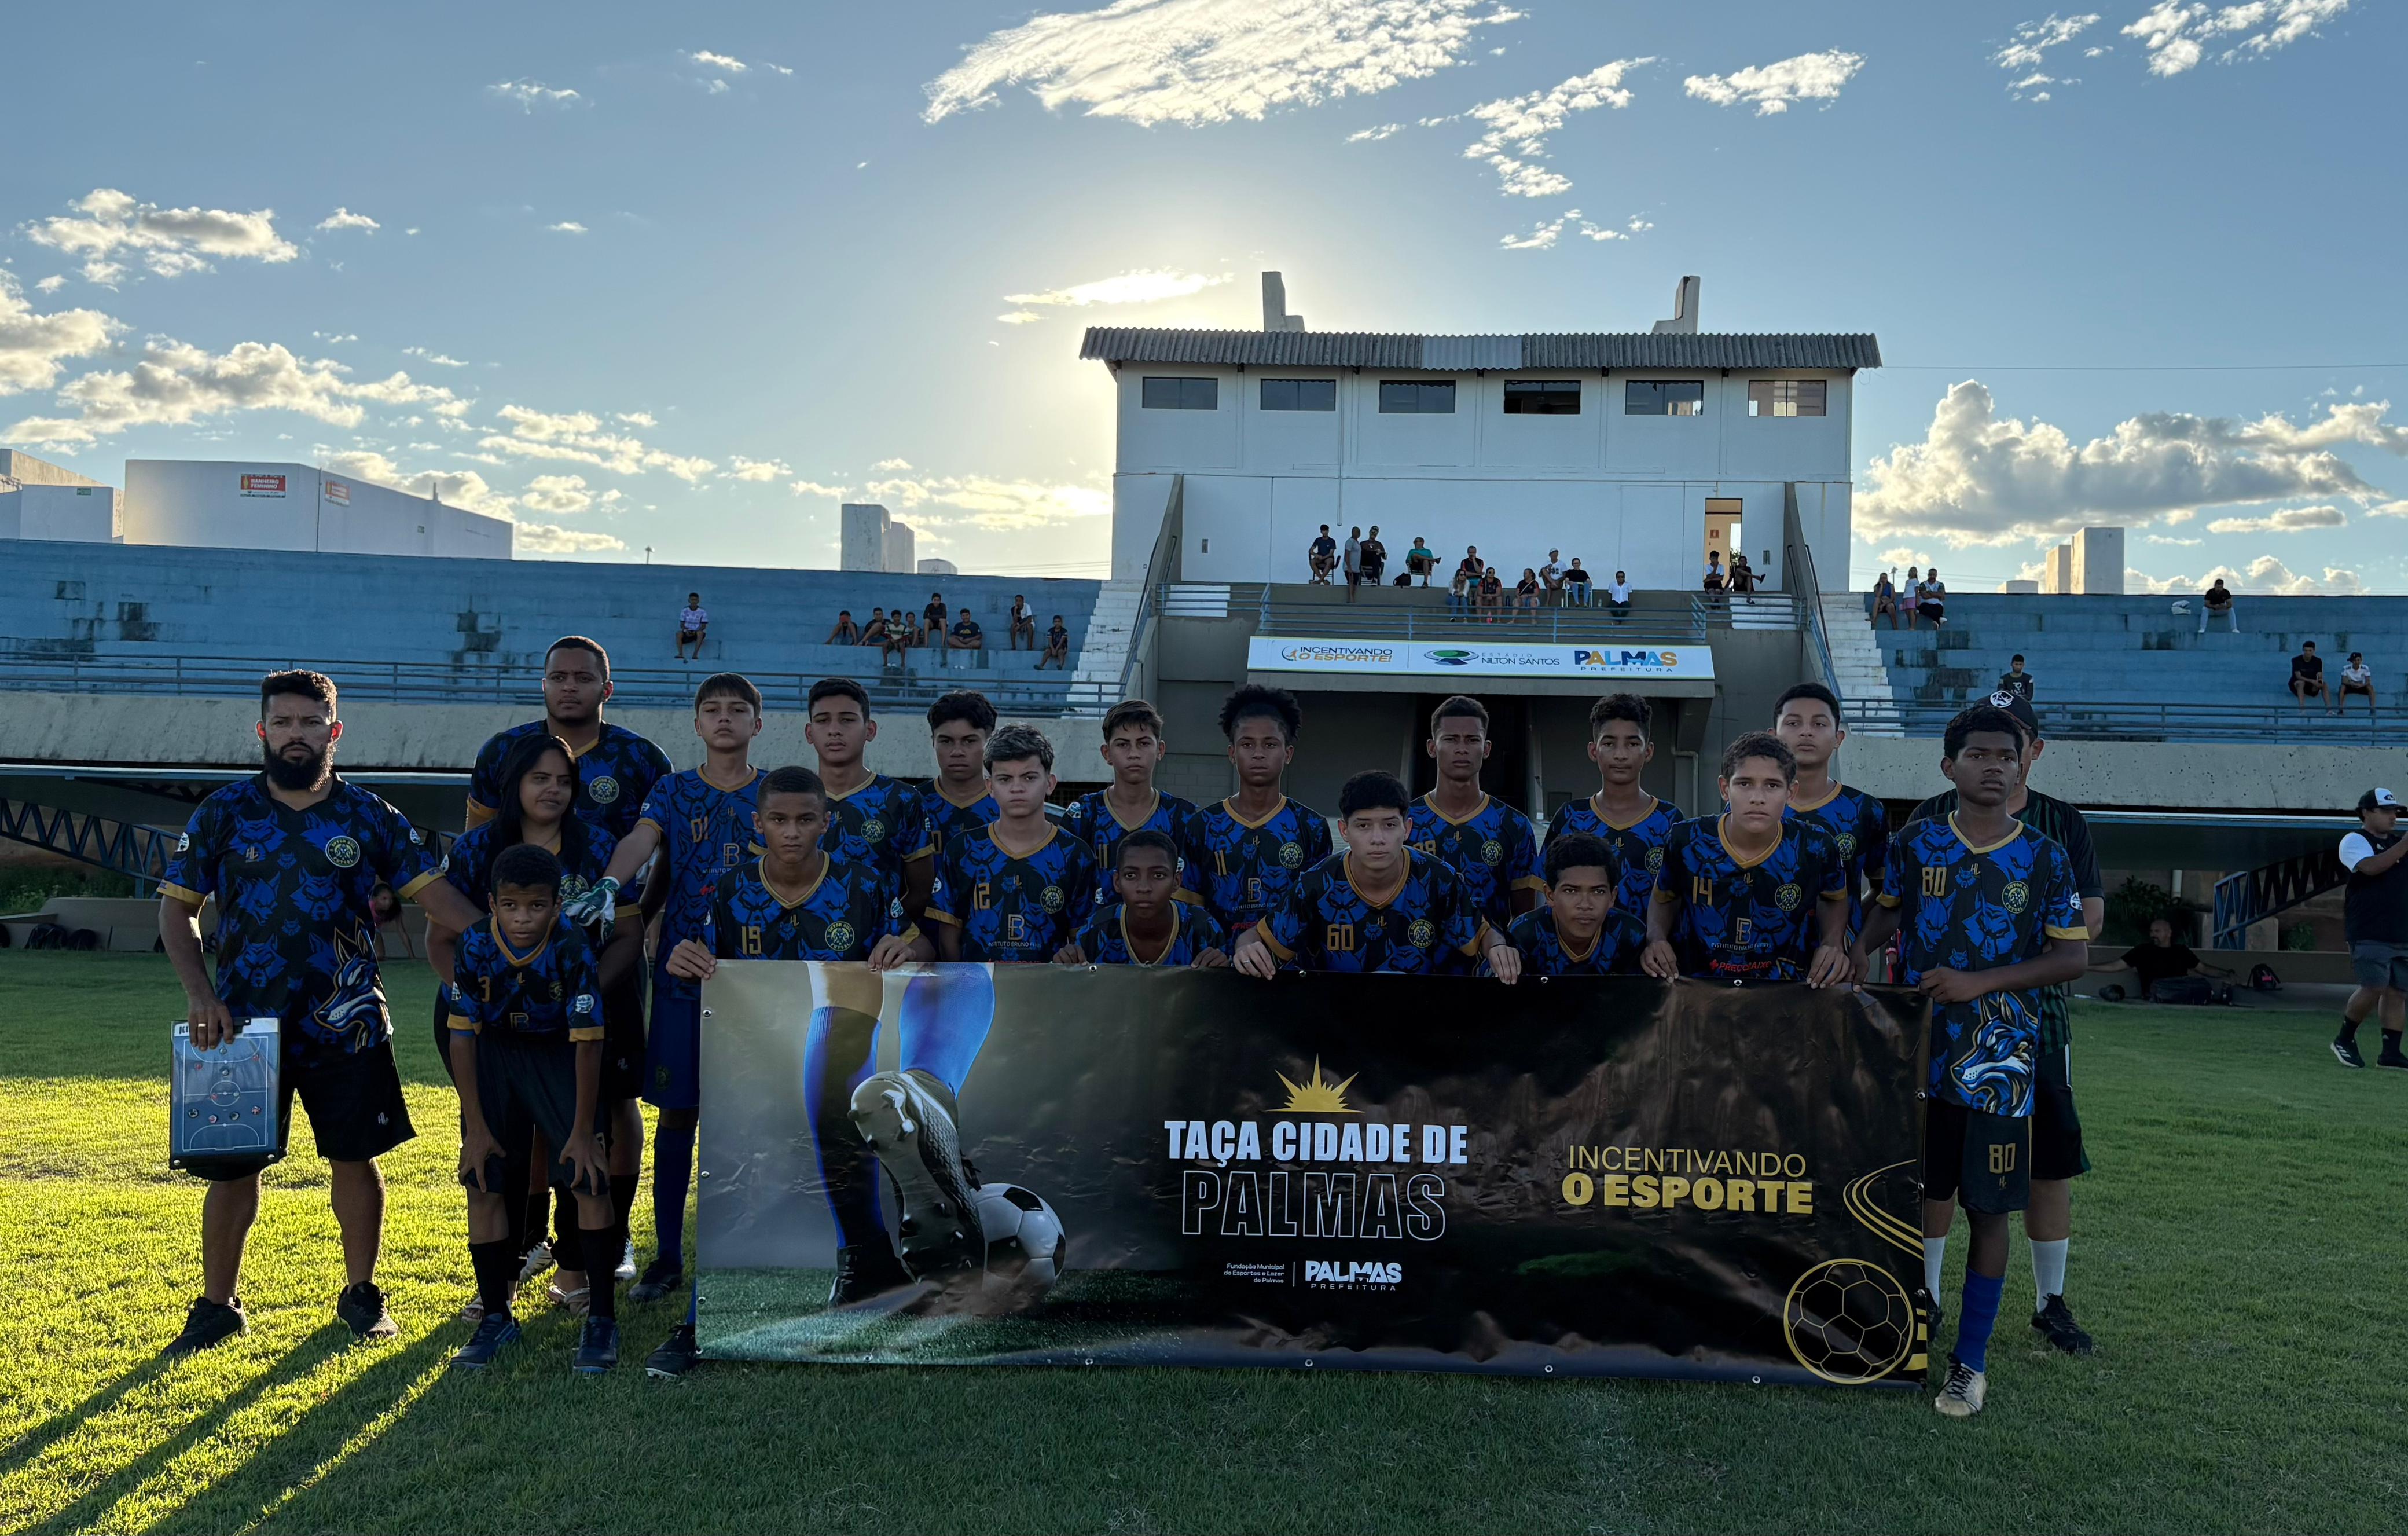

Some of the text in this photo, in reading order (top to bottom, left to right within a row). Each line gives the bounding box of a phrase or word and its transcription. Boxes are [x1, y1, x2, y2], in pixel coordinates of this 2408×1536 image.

[1300, 647, 1393, 655] INCENTIVANDO
[1314, 654, 1392, 662] ESPORTE!
[1574, 650, 1678, 666] PALMAS
[691, 815, 709, 843] 01
[1214, 849, 1227, 876] 11
[974, 882, 991, 910] 12
[1693, 875, 1713, 906] 14
[1922, 867, 1947, 897] 80
[741, 926, 762, 955] 19
[1327, 923, 1355, 951] 60
[1164, 1120, 1467, 1168] TAÇA CIDADE DE
[1989, 1142, 2016, 1174] 80
[1569, 1145, 1807, 1178] INCENTIVANDO
[1182, 1170, 1446, 1241] PALMAS
[1562, 1172, 1813, 1214] O ESPORTE
[1227, 1263, 1256, 1271] Fundação
[1305, 1260, 1402, 1284] PALMAS
